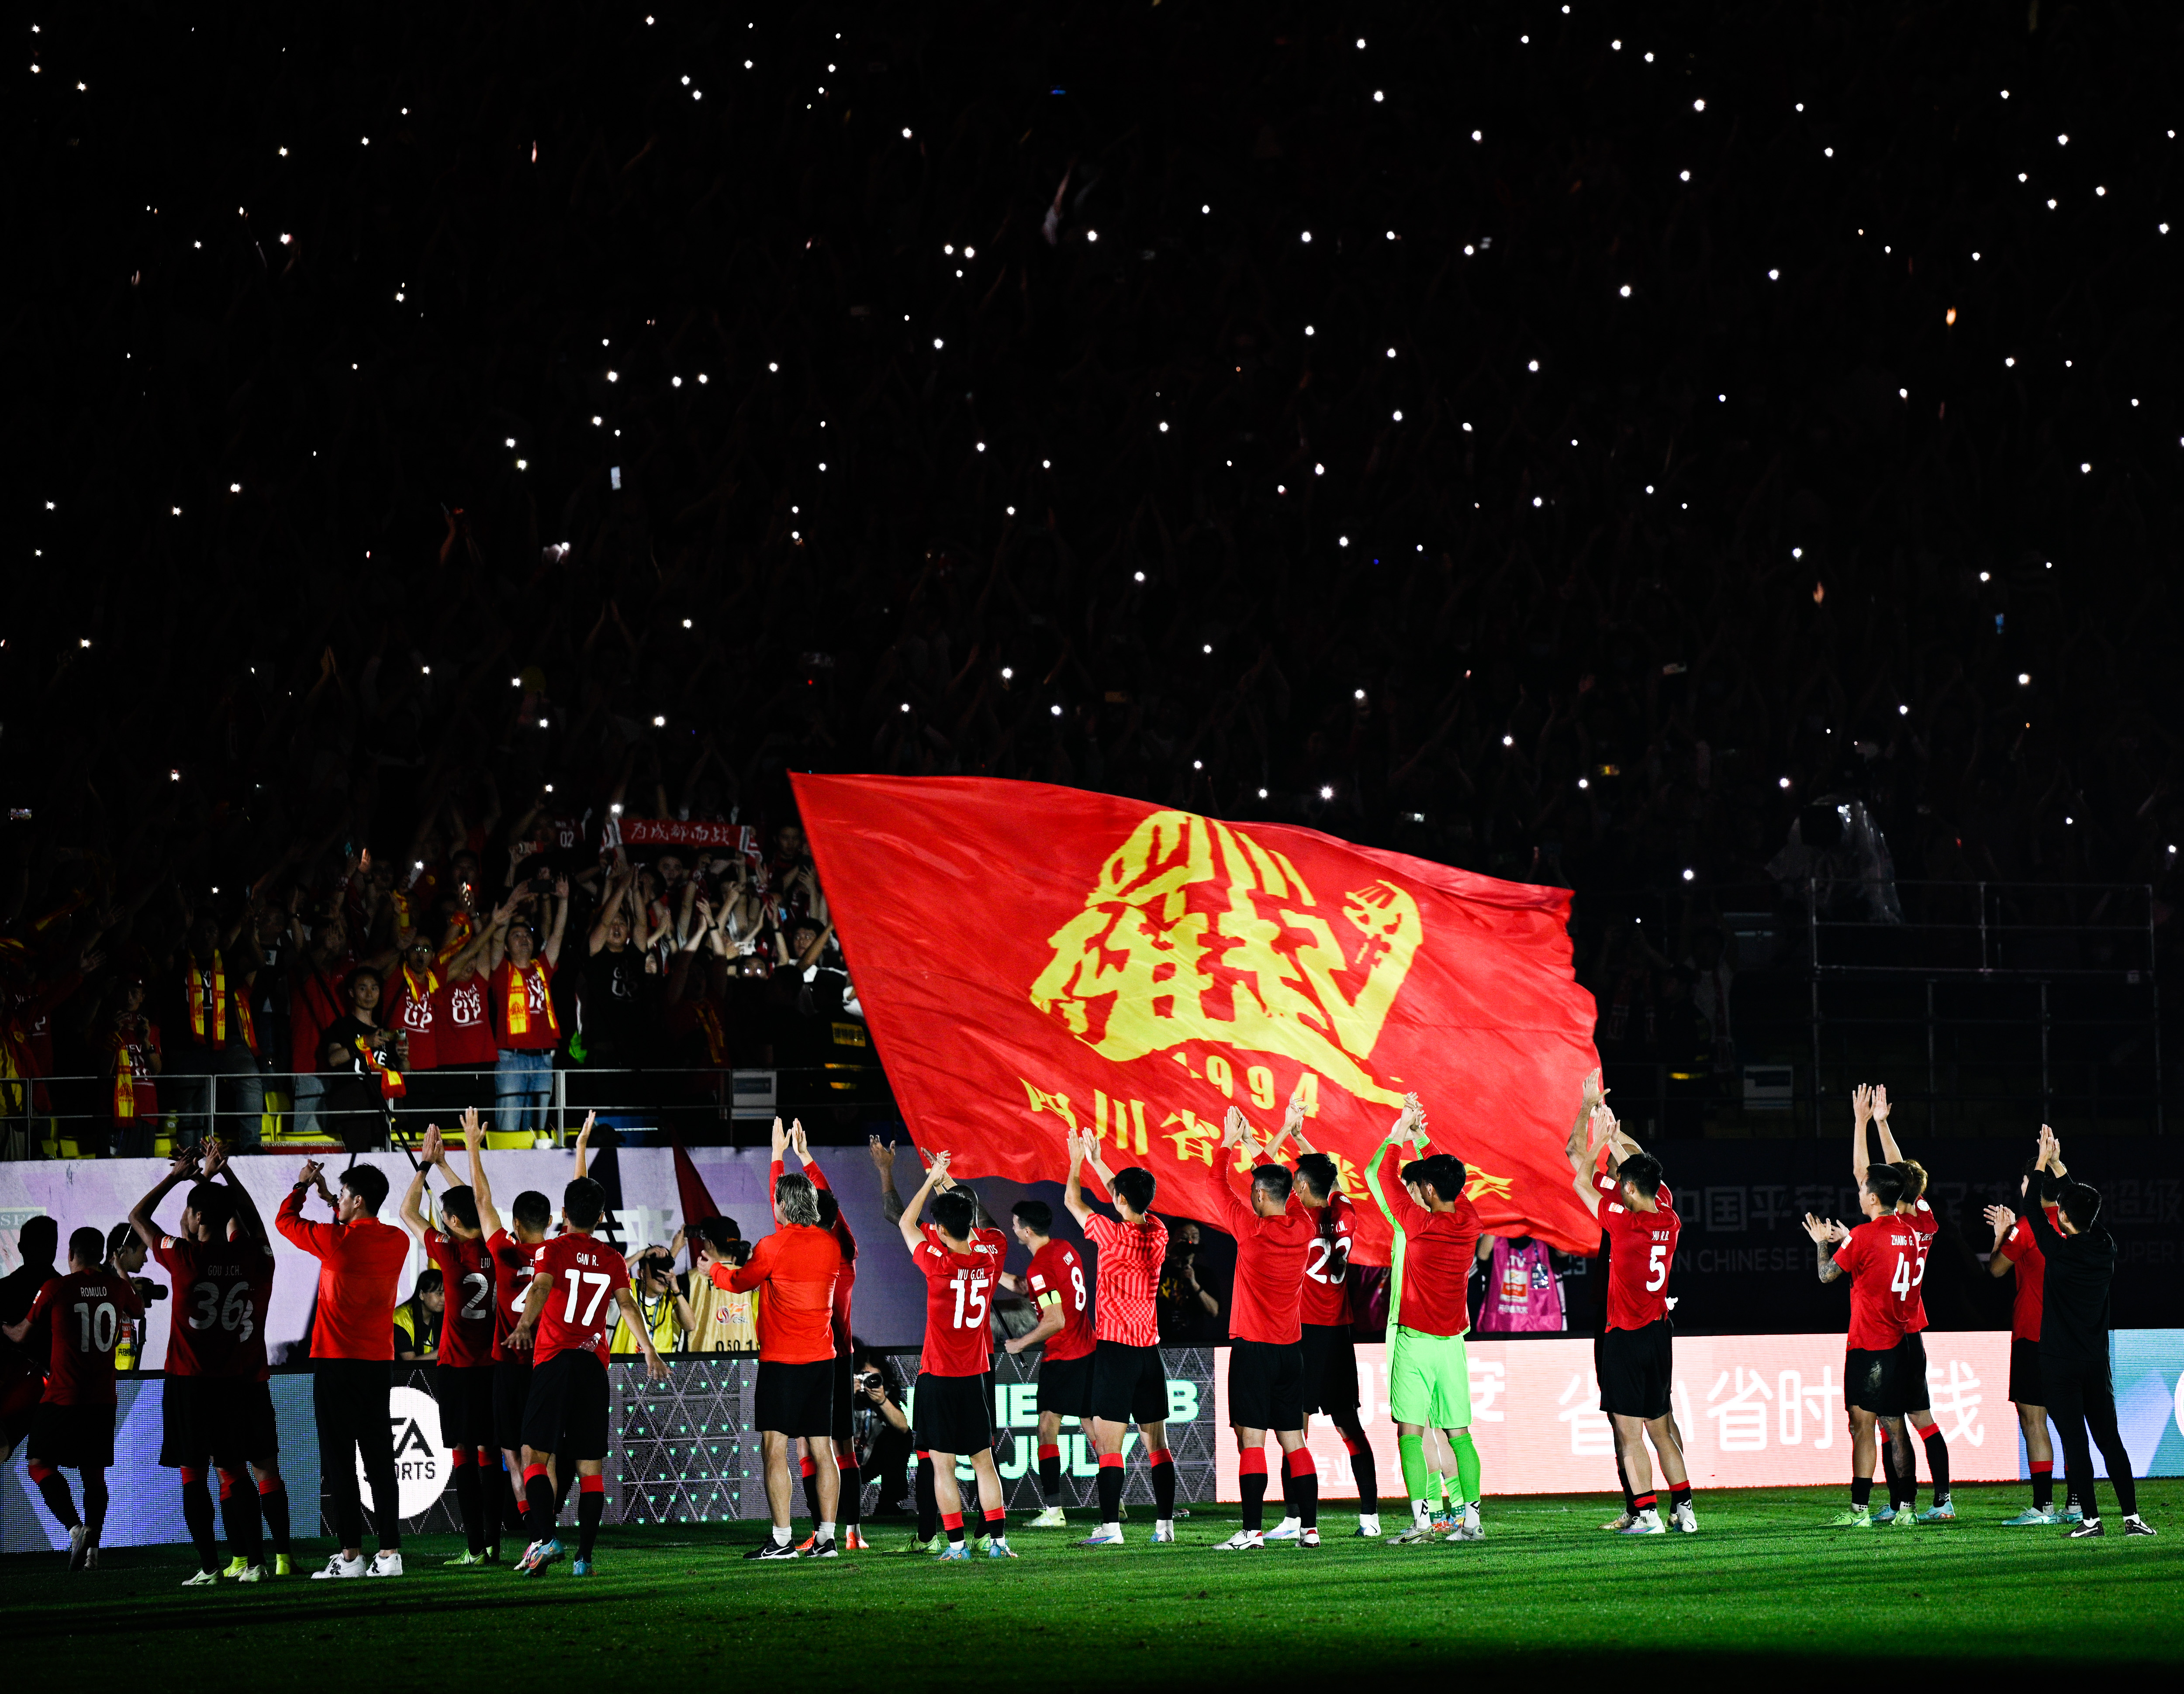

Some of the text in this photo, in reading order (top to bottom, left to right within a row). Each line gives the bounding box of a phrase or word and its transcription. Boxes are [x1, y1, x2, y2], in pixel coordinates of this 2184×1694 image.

[560, 831, 574, 848] 02
[631, 822, 730, 845] 为成都而战
[404, 1007, 432, 1028] UP
[1172, 1052, 1319, 1118] 1994
[1319, 1224, 1334, 1234] YANG
[1652, 1231, 1669, 1241] HU R.B.
[1891, 1235, 1914, 1246] ZHANG G.
[481, 1258, 490, 1269] LIU
[577, 1252, 599, 1266] GAN R.
[1306, 1237, 1351, 1284] 23
[1697, 1248, 1799, 1273] CHINESE
[2118, 1239, 2175, 1264] UPER
[208, 1265, 242, 1276] GOU J.CH.
[957, 1268, 985, 1280] WU G.CH.
[1646, 1245, 1666, 1291] 5
[1891, 1252, 1910, 1301] 4
[80, 1287, 107, 1297] ROMULO
[564, 1269, 611, 1327] 17
[1071, 1266, 1086, 1311] 8
[189, 1281, 249, 1331] 36
[950, 1279, 989, 1328] 15
[74, 1302, 117, 1352] 10
[390, 1417, 435, 1458] A
